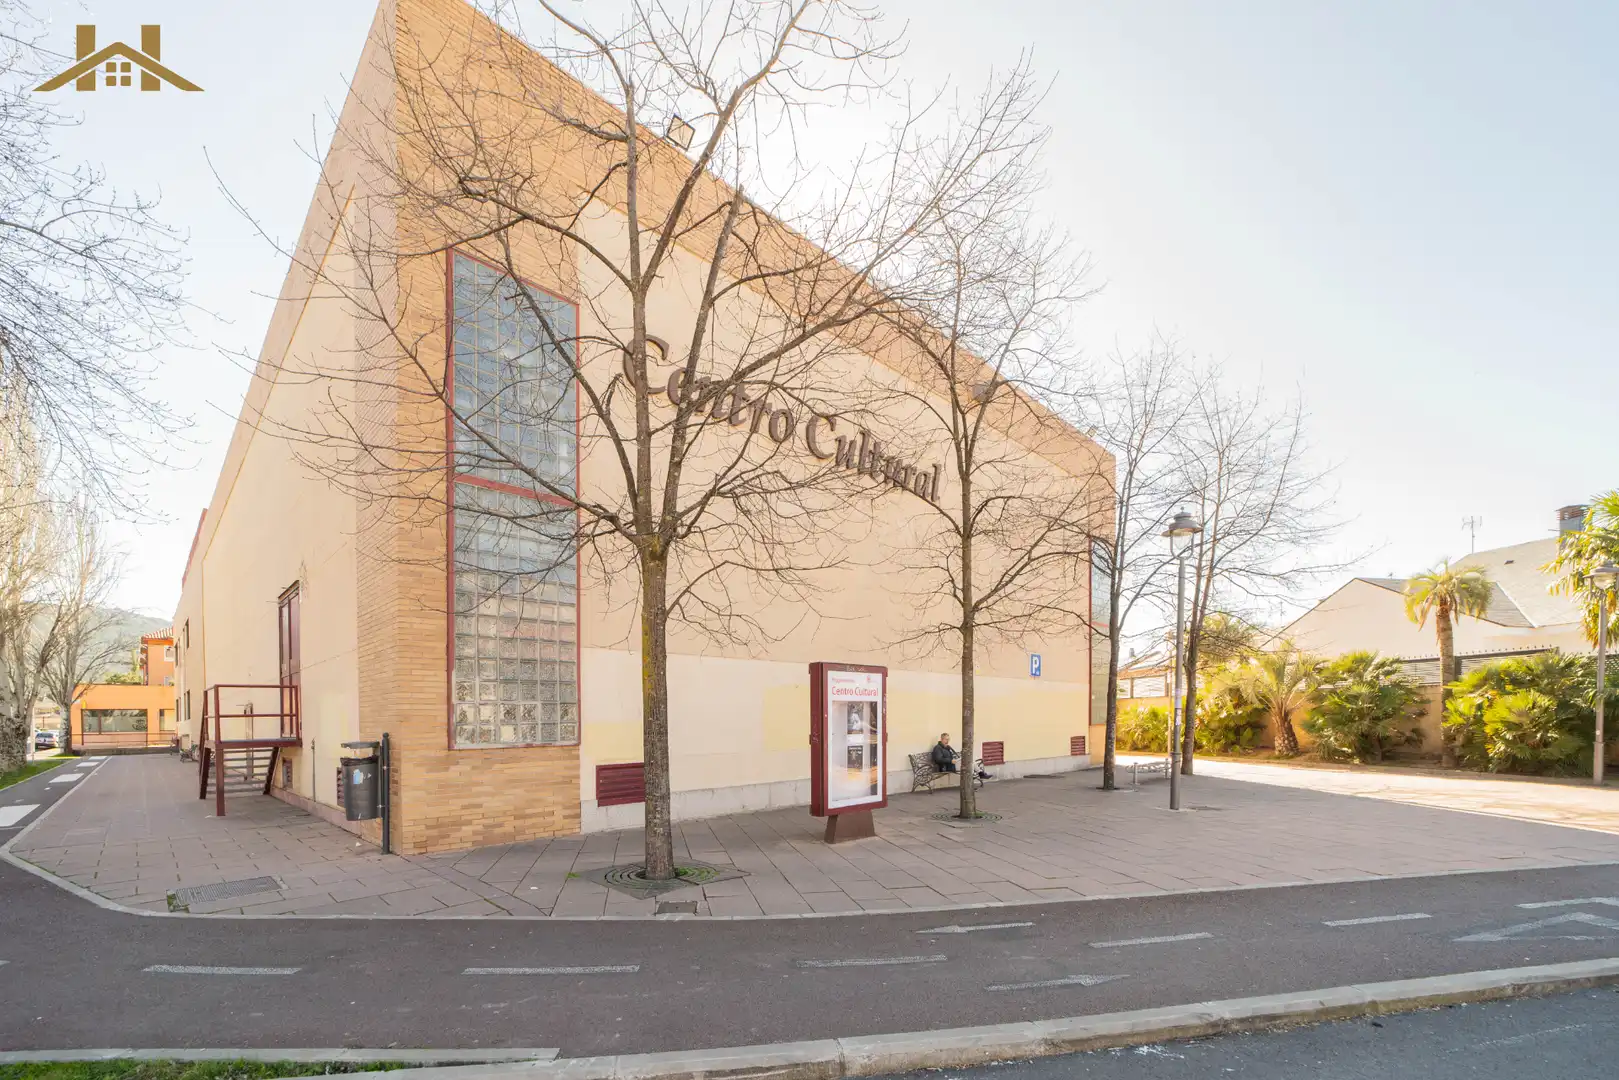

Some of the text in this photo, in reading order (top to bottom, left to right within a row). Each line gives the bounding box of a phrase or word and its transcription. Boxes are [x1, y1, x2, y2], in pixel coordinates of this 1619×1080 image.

[806, 414, 942, 502] Cultural
[1032, 655, 1040, 673] P
[831, 685, 879, 697] Centro Cultural
